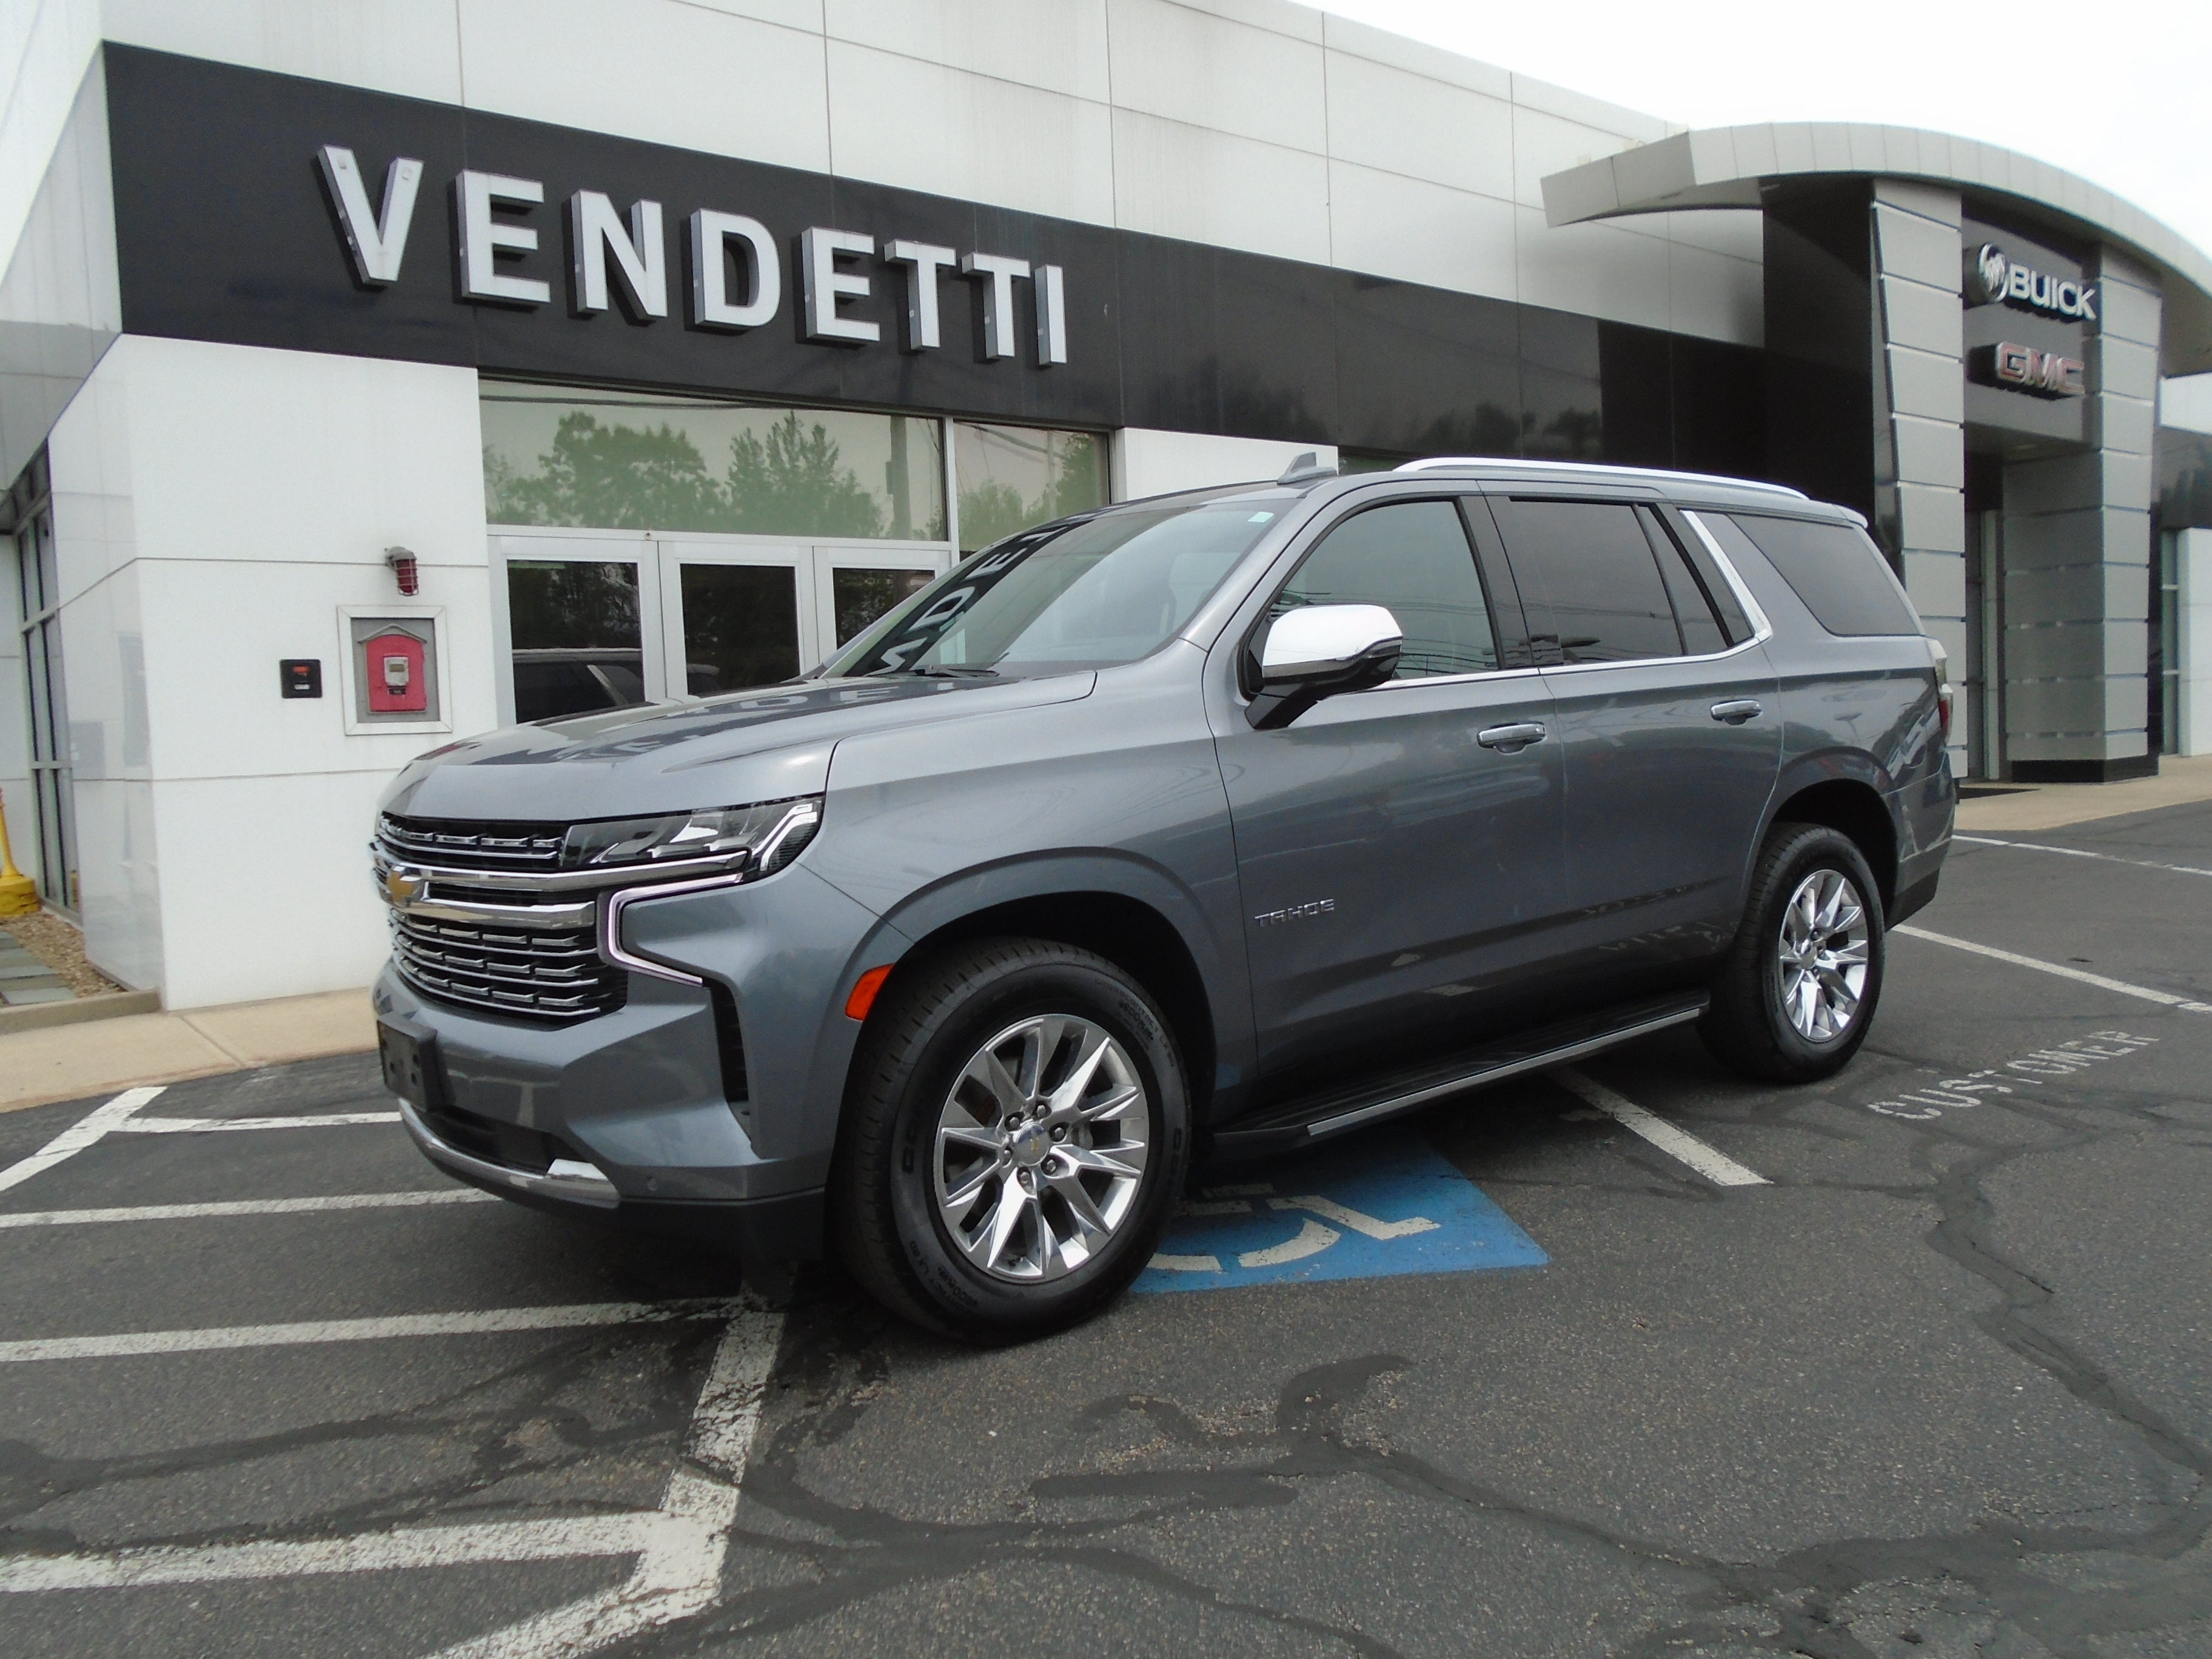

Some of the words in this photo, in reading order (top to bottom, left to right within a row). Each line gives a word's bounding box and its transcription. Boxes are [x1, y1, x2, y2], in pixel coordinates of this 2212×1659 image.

[317, 144, 1067, 366] VENDETTI
[2009, 263, 2097, 320] BUICK
[1996, 341, 2085, 395] GMC
[1255, 899, 1335, 927] TAHOE
[1867, 1029, 2160, 1121] CUSTOMER
